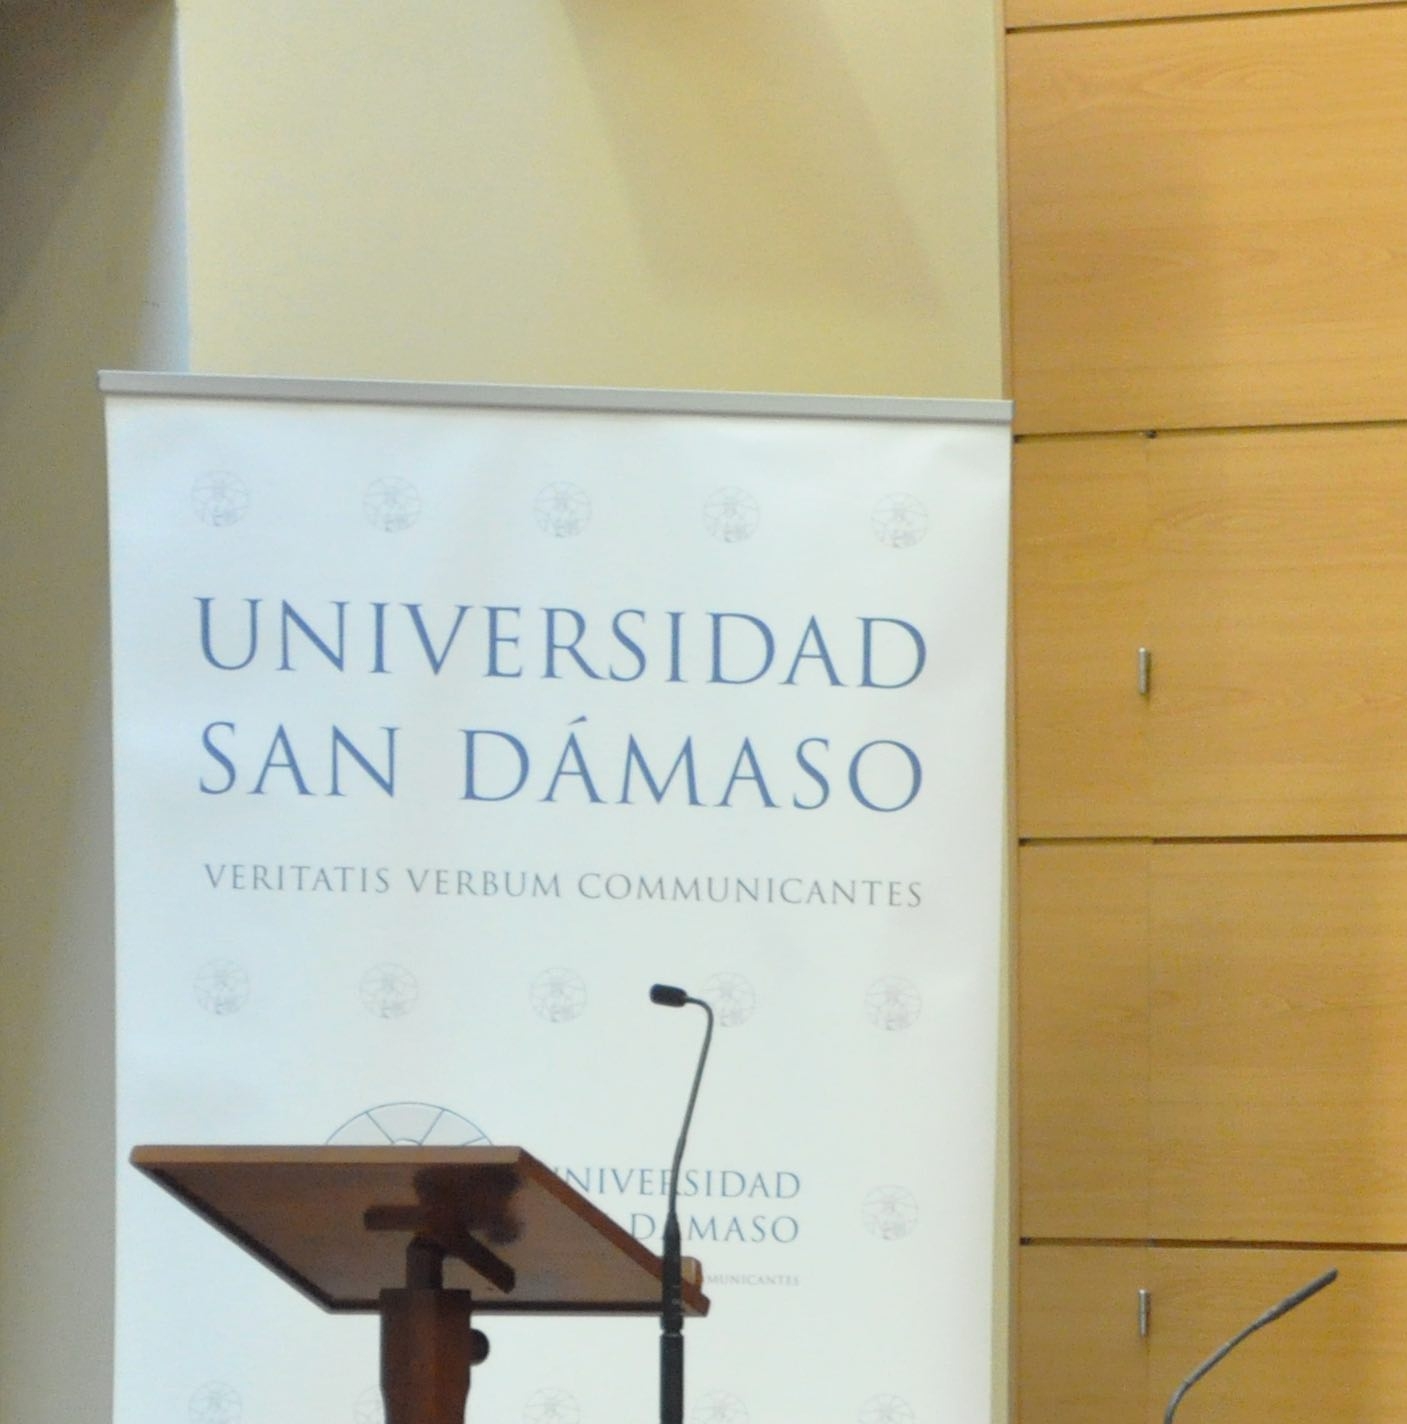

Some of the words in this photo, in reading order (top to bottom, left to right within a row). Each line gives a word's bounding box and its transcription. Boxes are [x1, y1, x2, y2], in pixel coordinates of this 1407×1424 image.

[194, 596, 928, 691] UNIVERSIDAD
[199, 720, 400, 799] SAN
[461, 715, 924, 814] DÁMASO
[203, 862, 391, 895] VERITATIS
[405, 867, 562, 899] VERBUM
[577, 872, 923, 909] COMMUNICANTES
[554, 1166, 802, 1200] NIVERSIDAD
[630, 1213, 800, 1243] DMASO
